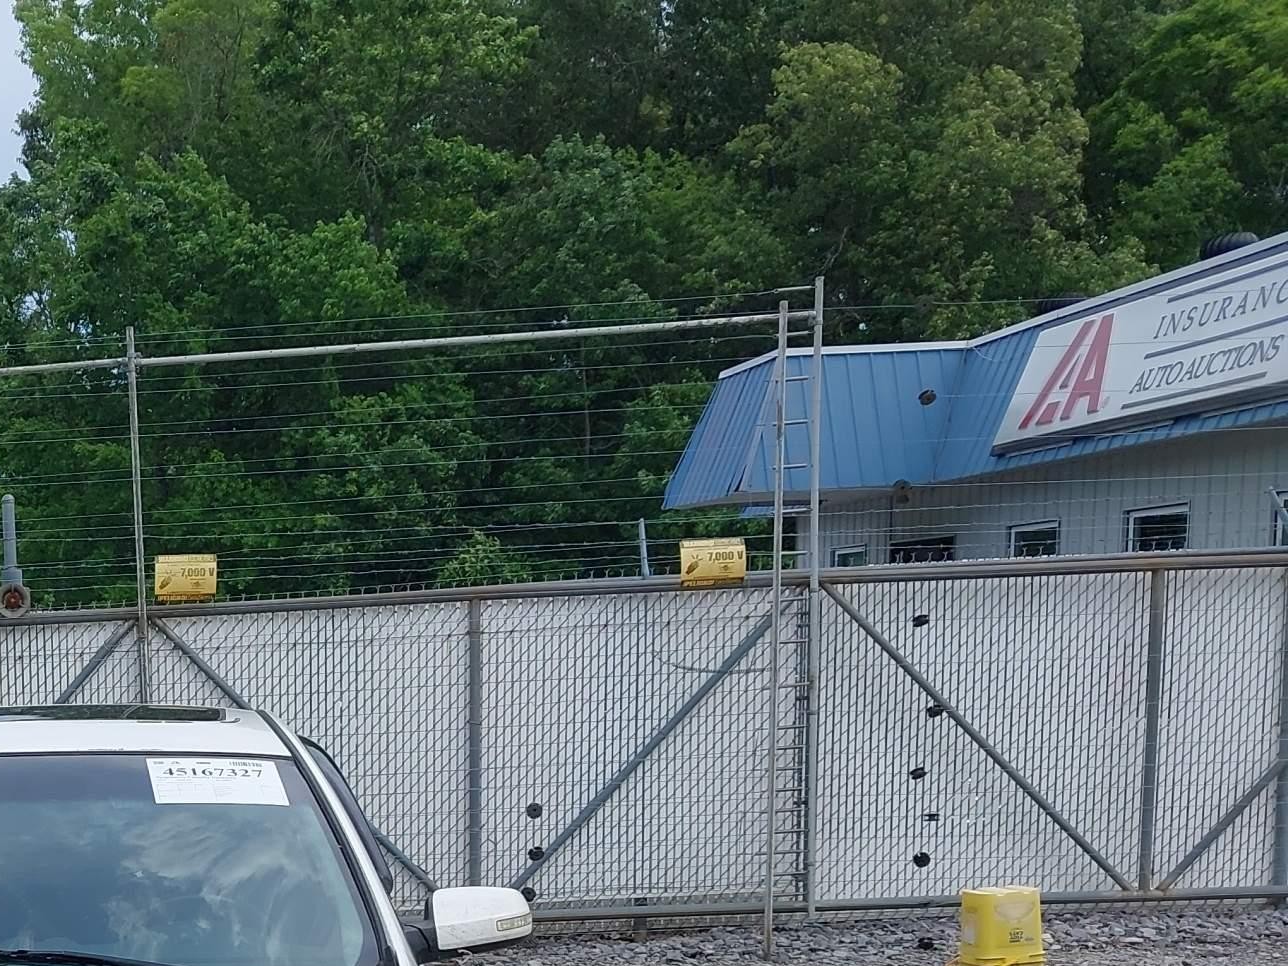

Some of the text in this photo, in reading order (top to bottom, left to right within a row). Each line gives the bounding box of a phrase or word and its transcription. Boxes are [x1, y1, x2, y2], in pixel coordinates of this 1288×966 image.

[707, 551, 734, 563] 7,000
[180, 567, 206, 579] 7,000
[162, 767, 262, 778] 45167327
